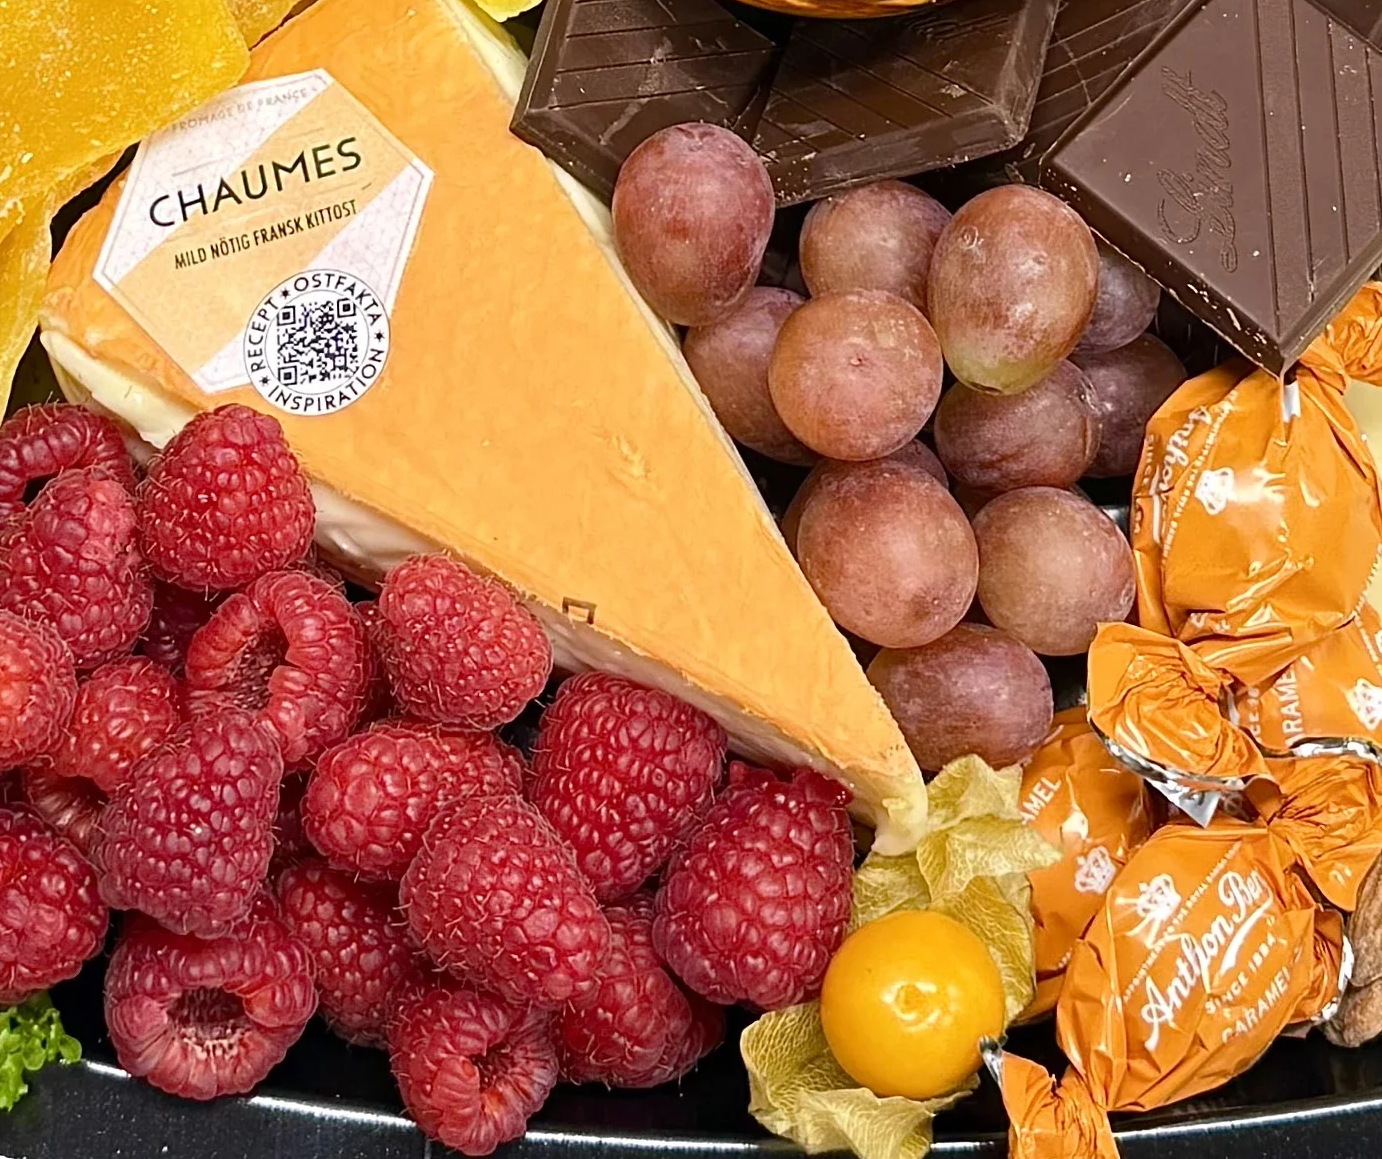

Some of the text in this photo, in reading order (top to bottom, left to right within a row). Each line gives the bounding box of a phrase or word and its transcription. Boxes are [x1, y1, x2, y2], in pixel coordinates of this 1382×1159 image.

[148, 136, 363, 229] CHAUMES
[174, 199, 358, 270] MILD NÖTIG FRANSK KITTOST
[248, 272, 382, 374] RECEPT OSTFAKTA
[267, 348, 386, 412] INSPIRATION
[1140, 913, 1235, 1052] Anthon
[1204, 972, 1249, 1015] SINCE
